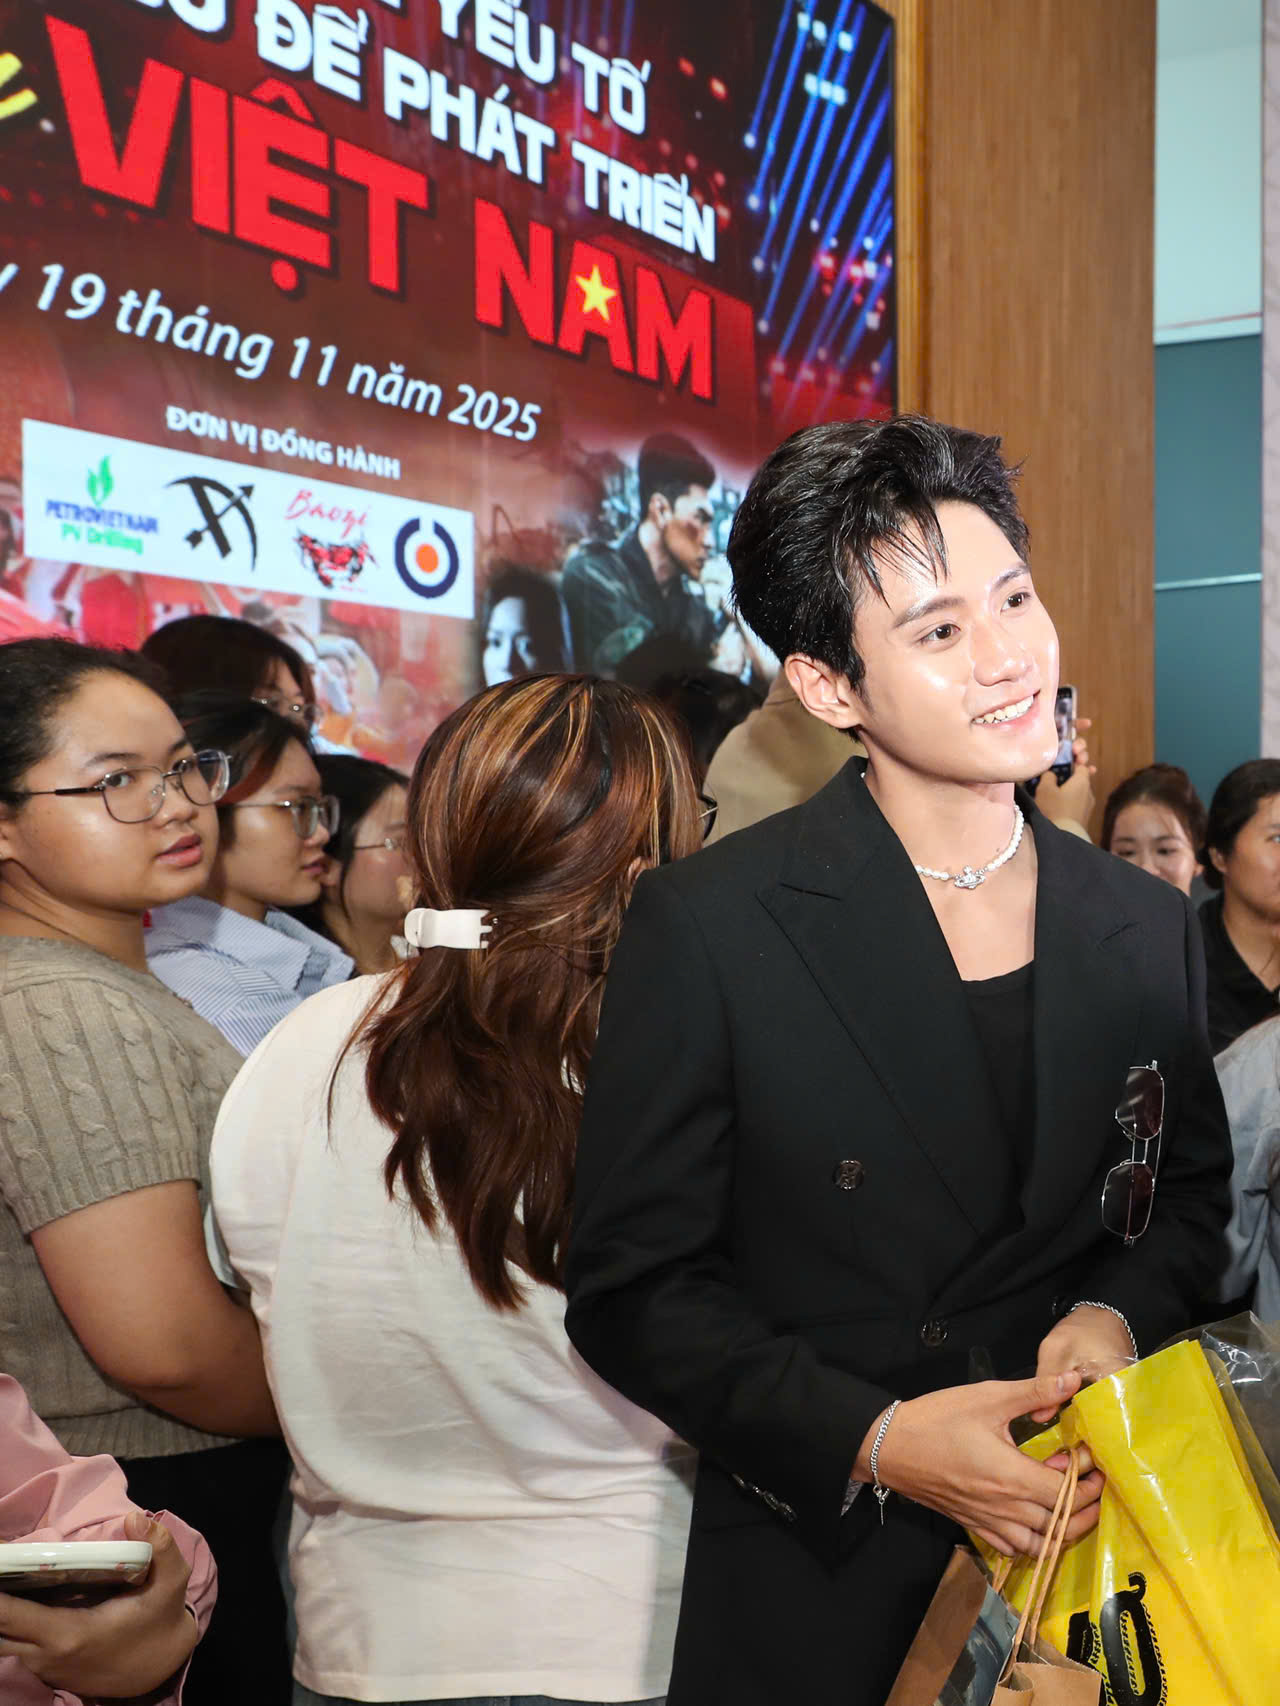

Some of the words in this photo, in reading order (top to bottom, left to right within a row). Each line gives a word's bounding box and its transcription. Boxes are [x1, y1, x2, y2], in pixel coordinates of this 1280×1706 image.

[254, 0, 369, 101] ĐỂ
[383, 46, 555, 184] PHÁT
[571, 139, 716, 263] TRIỂN
[572, 42, 651, 135] TỐ
[45, 14, 428, 292] VIỆT
[475, 198, 713, 399] NAM
[37, 263, 106, 320] 19
[116, 289, 274, 380] tháng
[289, 336, 338, 387] 11
[346, 361, 442, 416] năm
[447, 383, 542, 441] 2025
[231, 420, 258, 454] VỊ
